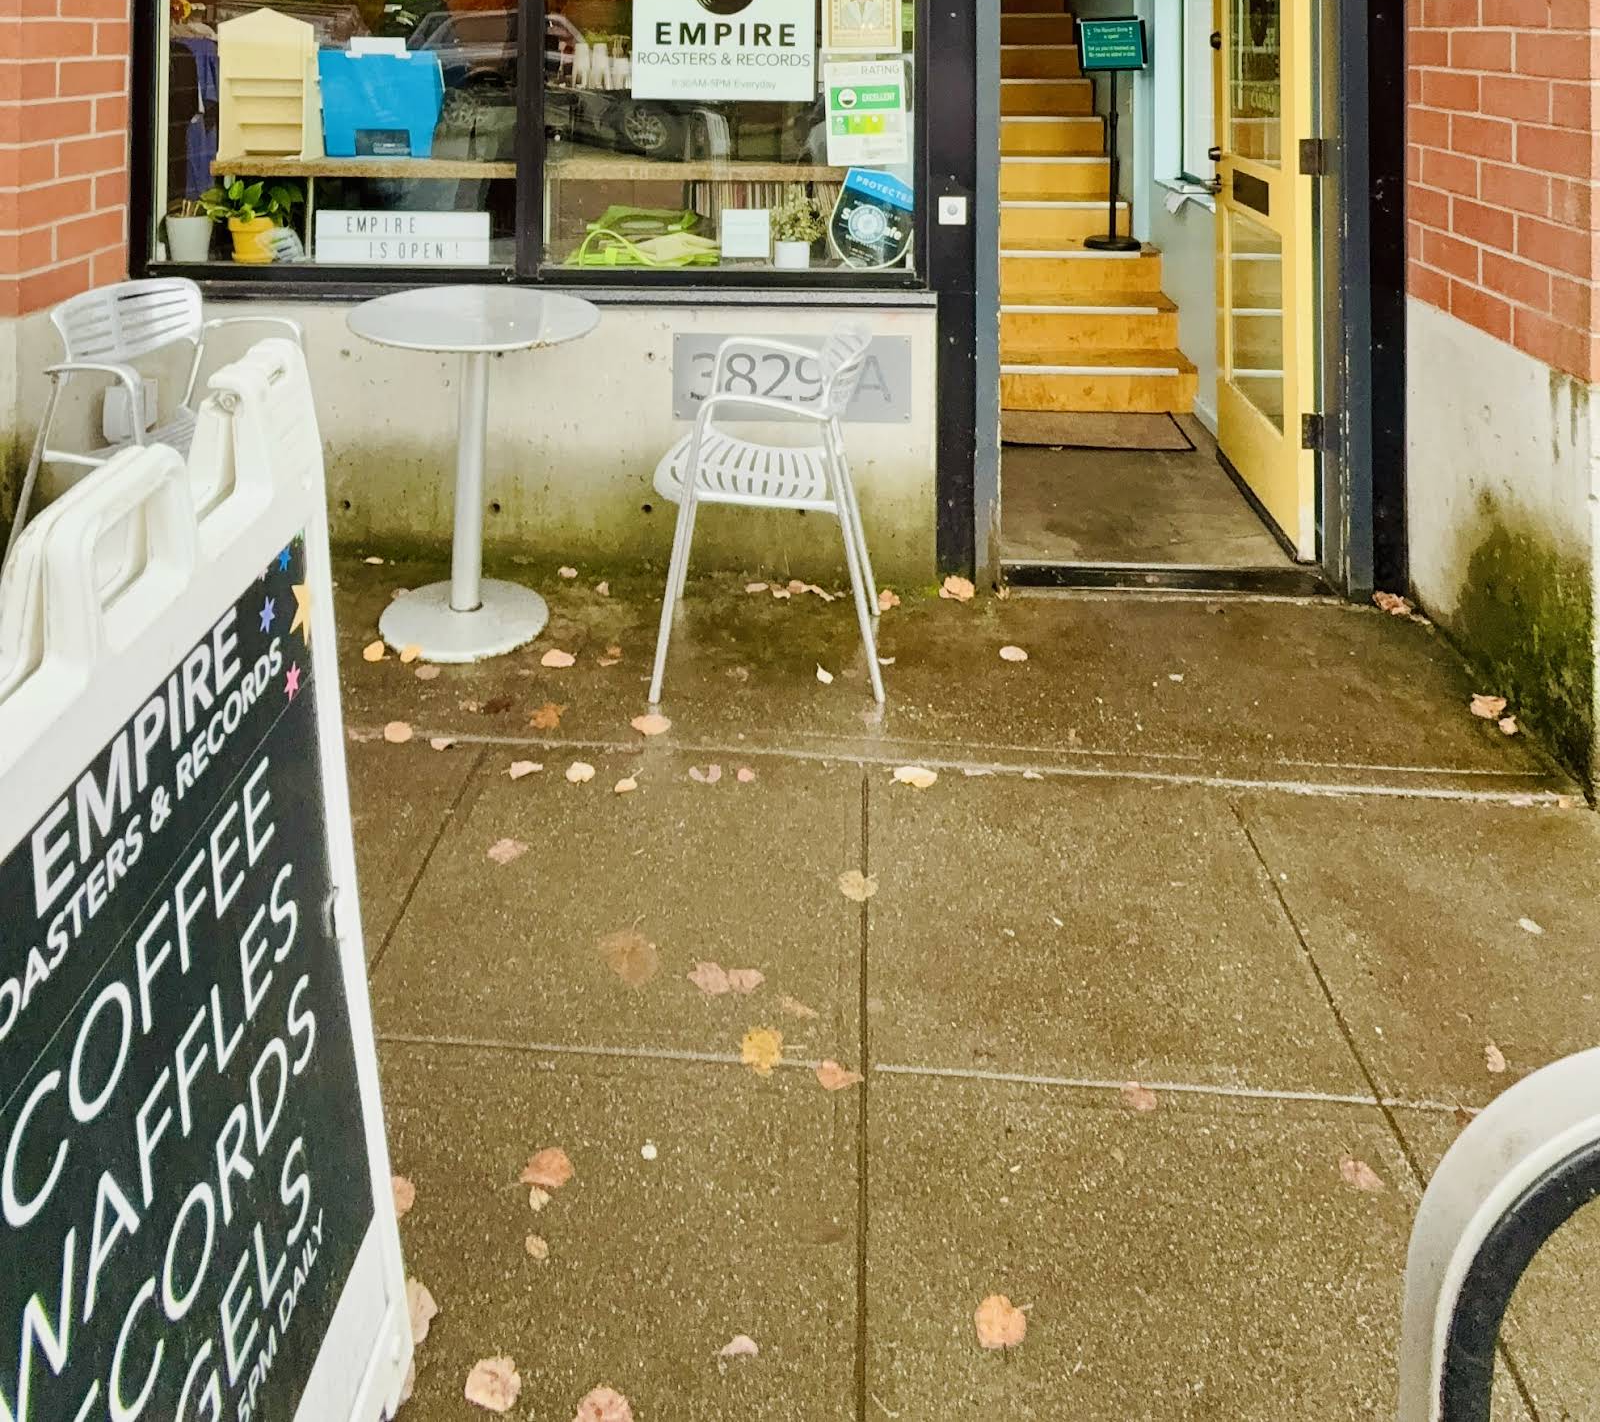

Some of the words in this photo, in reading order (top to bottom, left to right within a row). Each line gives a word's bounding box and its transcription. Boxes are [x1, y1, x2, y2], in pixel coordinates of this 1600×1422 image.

[637, 51, 717, 66] ROASTERS
[720, 52, 731, 66] &
[736, 52, 811, 67] RECORDS
[655, 22, 796, 47] EMPIRE
[861, 65, 899, 75] RATING
[346, 216, 416, 235] EMPIRE
[369, 242, 387, 259] IS
[31, 606, 241, 920] EMPIRE
[150, 785, 172, 834] &
[176, 636, 282, 800] RECORDS
[2, 756, 275, 1228] COFFEE
[74, 974, 316, 1422] CORDS
[279, 1207, 324, 1335] DAILY
